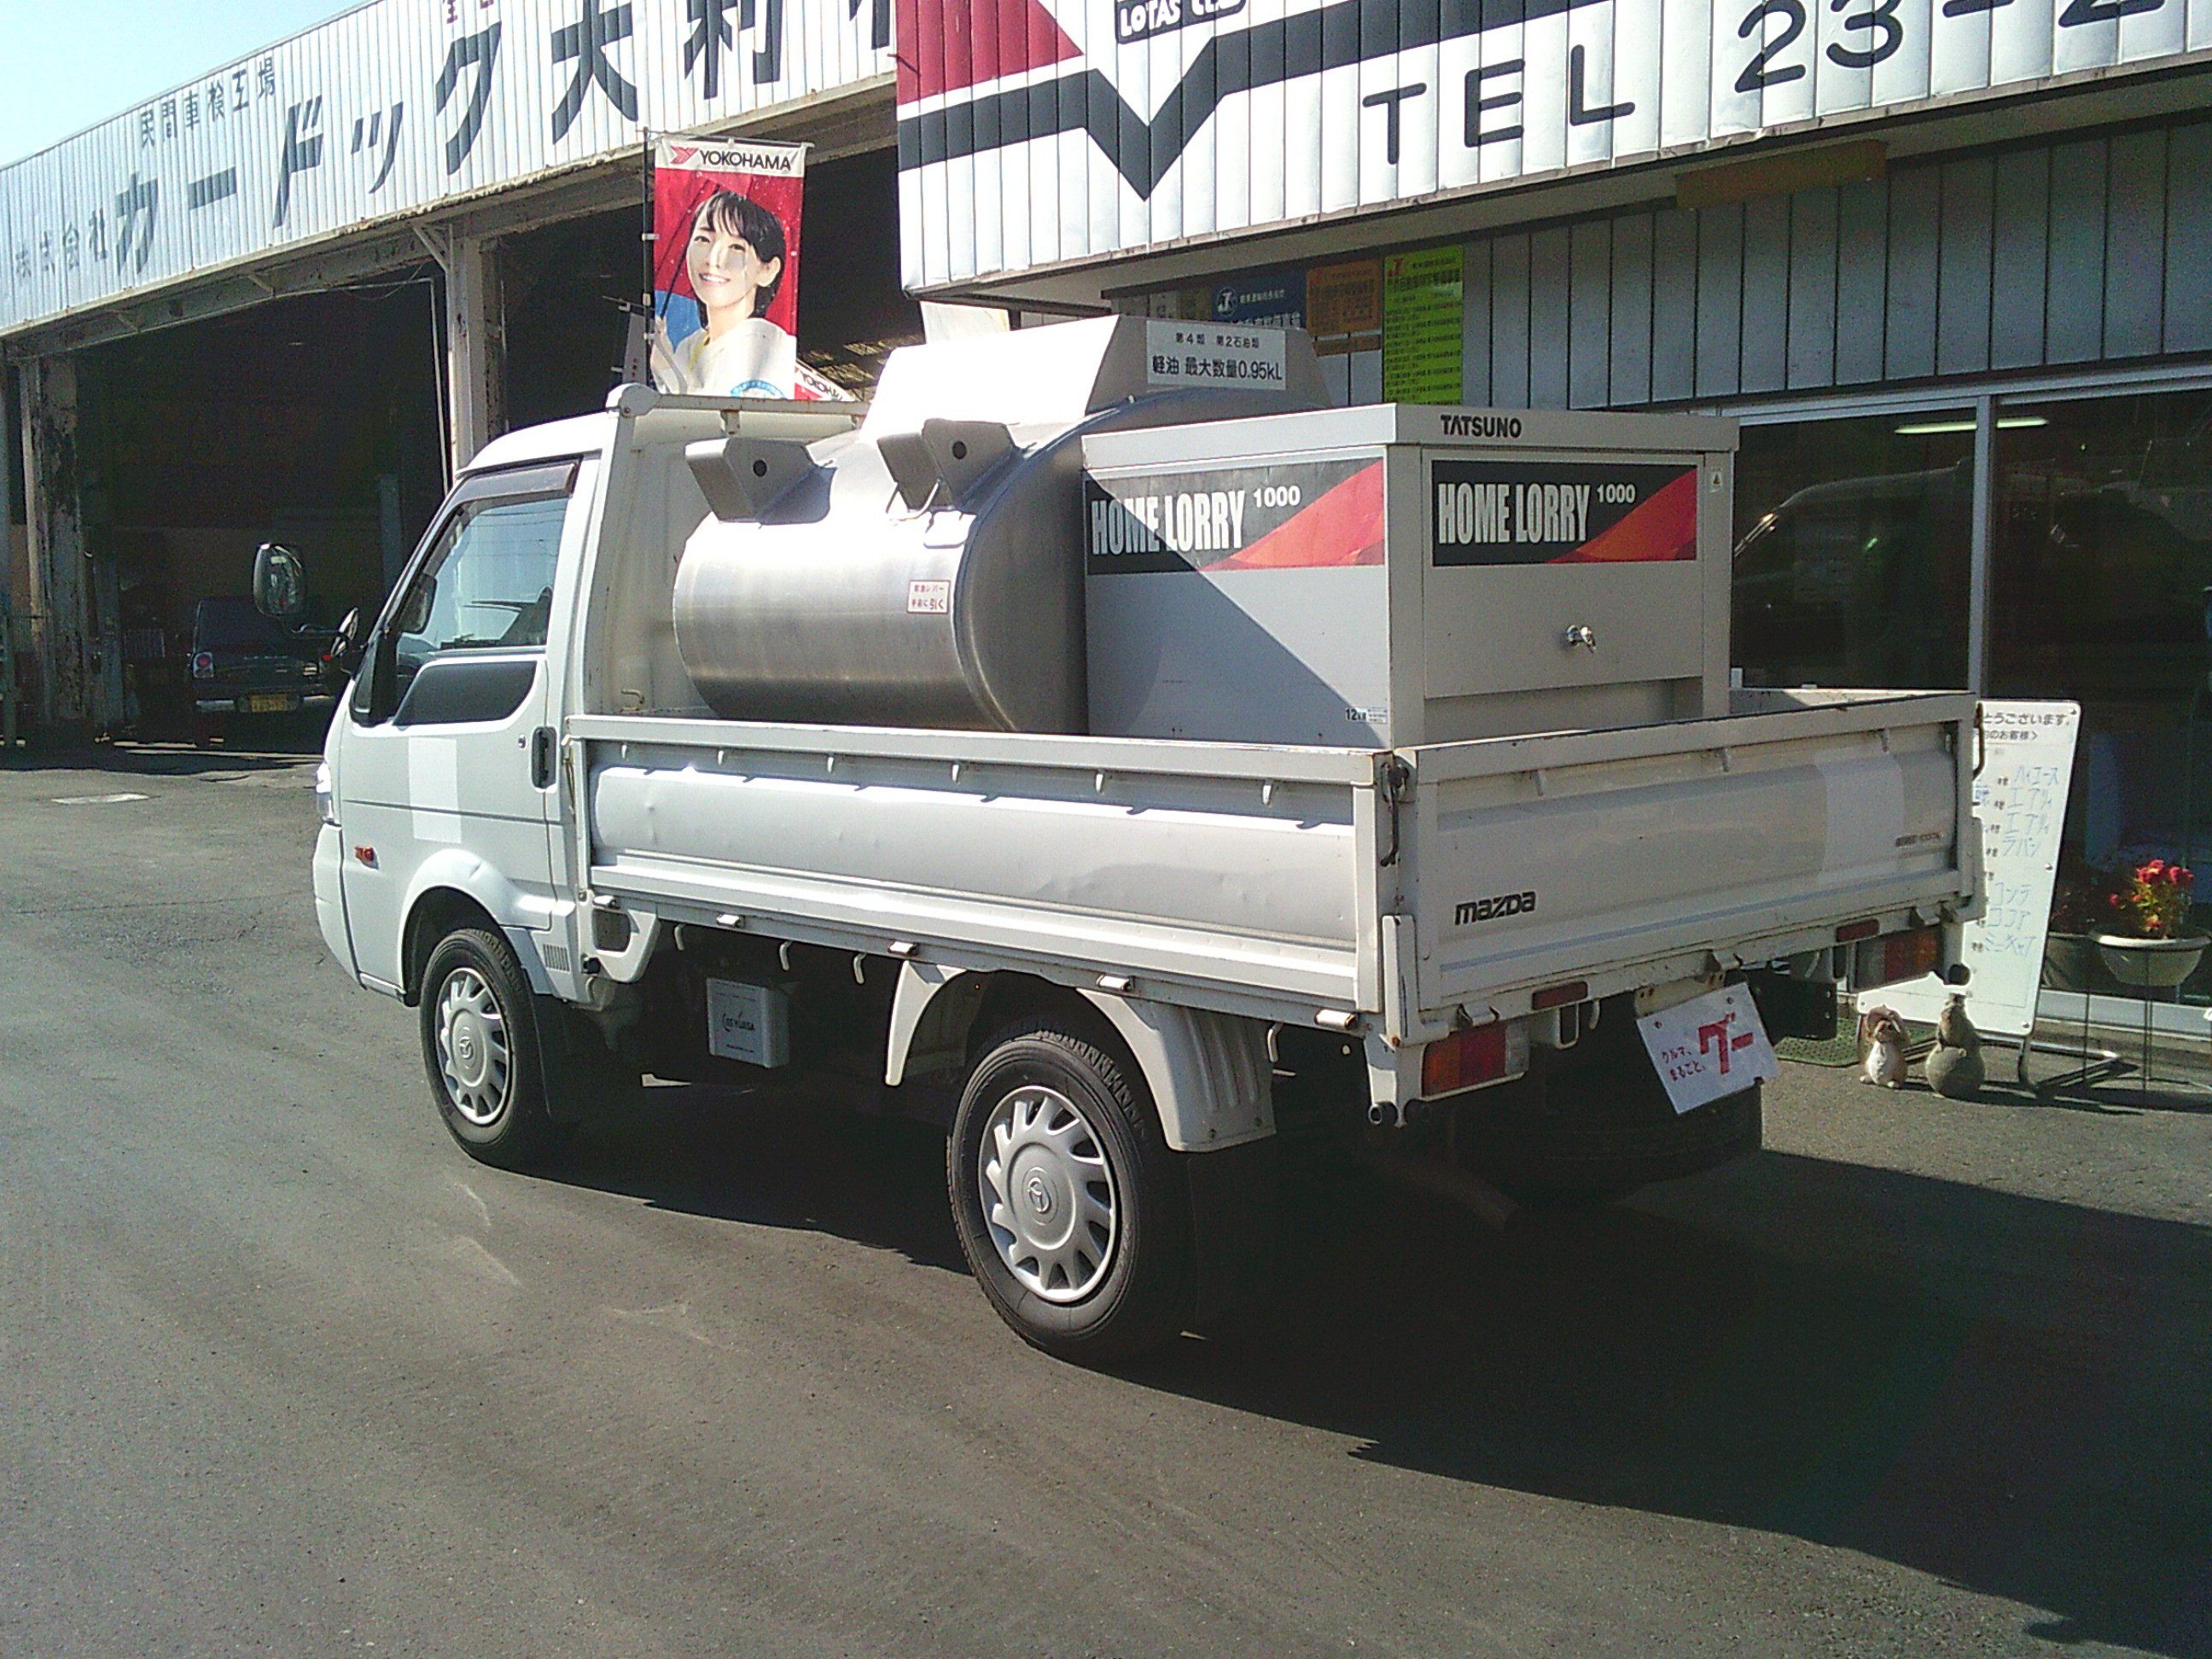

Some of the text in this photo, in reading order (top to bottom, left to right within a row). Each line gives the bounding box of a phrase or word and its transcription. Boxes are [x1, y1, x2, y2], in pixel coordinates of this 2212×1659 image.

[1120, 0, 1182, 38] LOTAS
[1362, 44, 1636, 165] TEL
[700, 149, 792, 171] YOKOHAMA
[1152, 355, 1180, 375] 軽油
[1441, 414, 1522, 439] TATSUNO
[1091, 485, 1301, 555] HOME LORRY 1000
[1438, 481, 1636, 545] HOME LORRY 1000
[1697, 1012, 1755, 1075] グー
